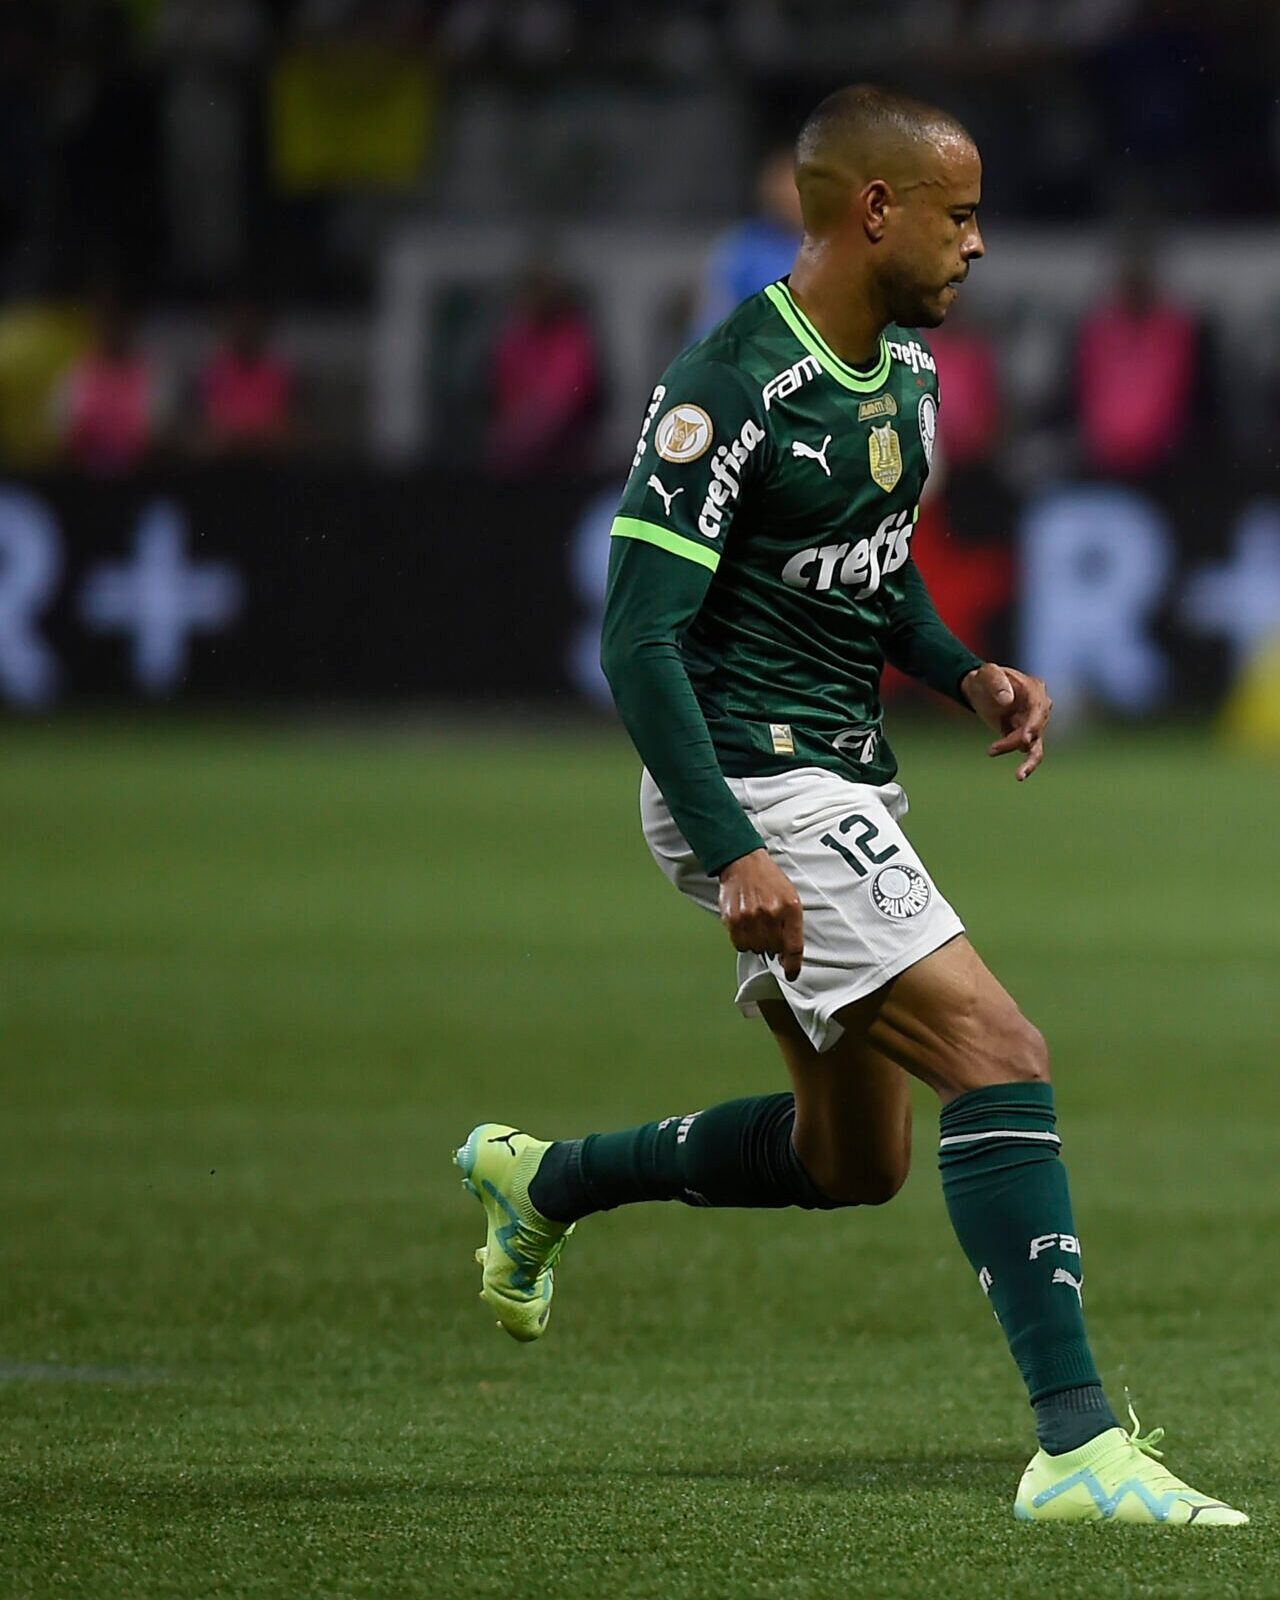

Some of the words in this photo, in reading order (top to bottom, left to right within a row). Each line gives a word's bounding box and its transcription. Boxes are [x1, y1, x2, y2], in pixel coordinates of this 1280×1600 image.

[698, 419, 766, 539] crefisa
[819, 814, 900, 877] 12
[877, 875, 929, 919] PALMEIRAS
